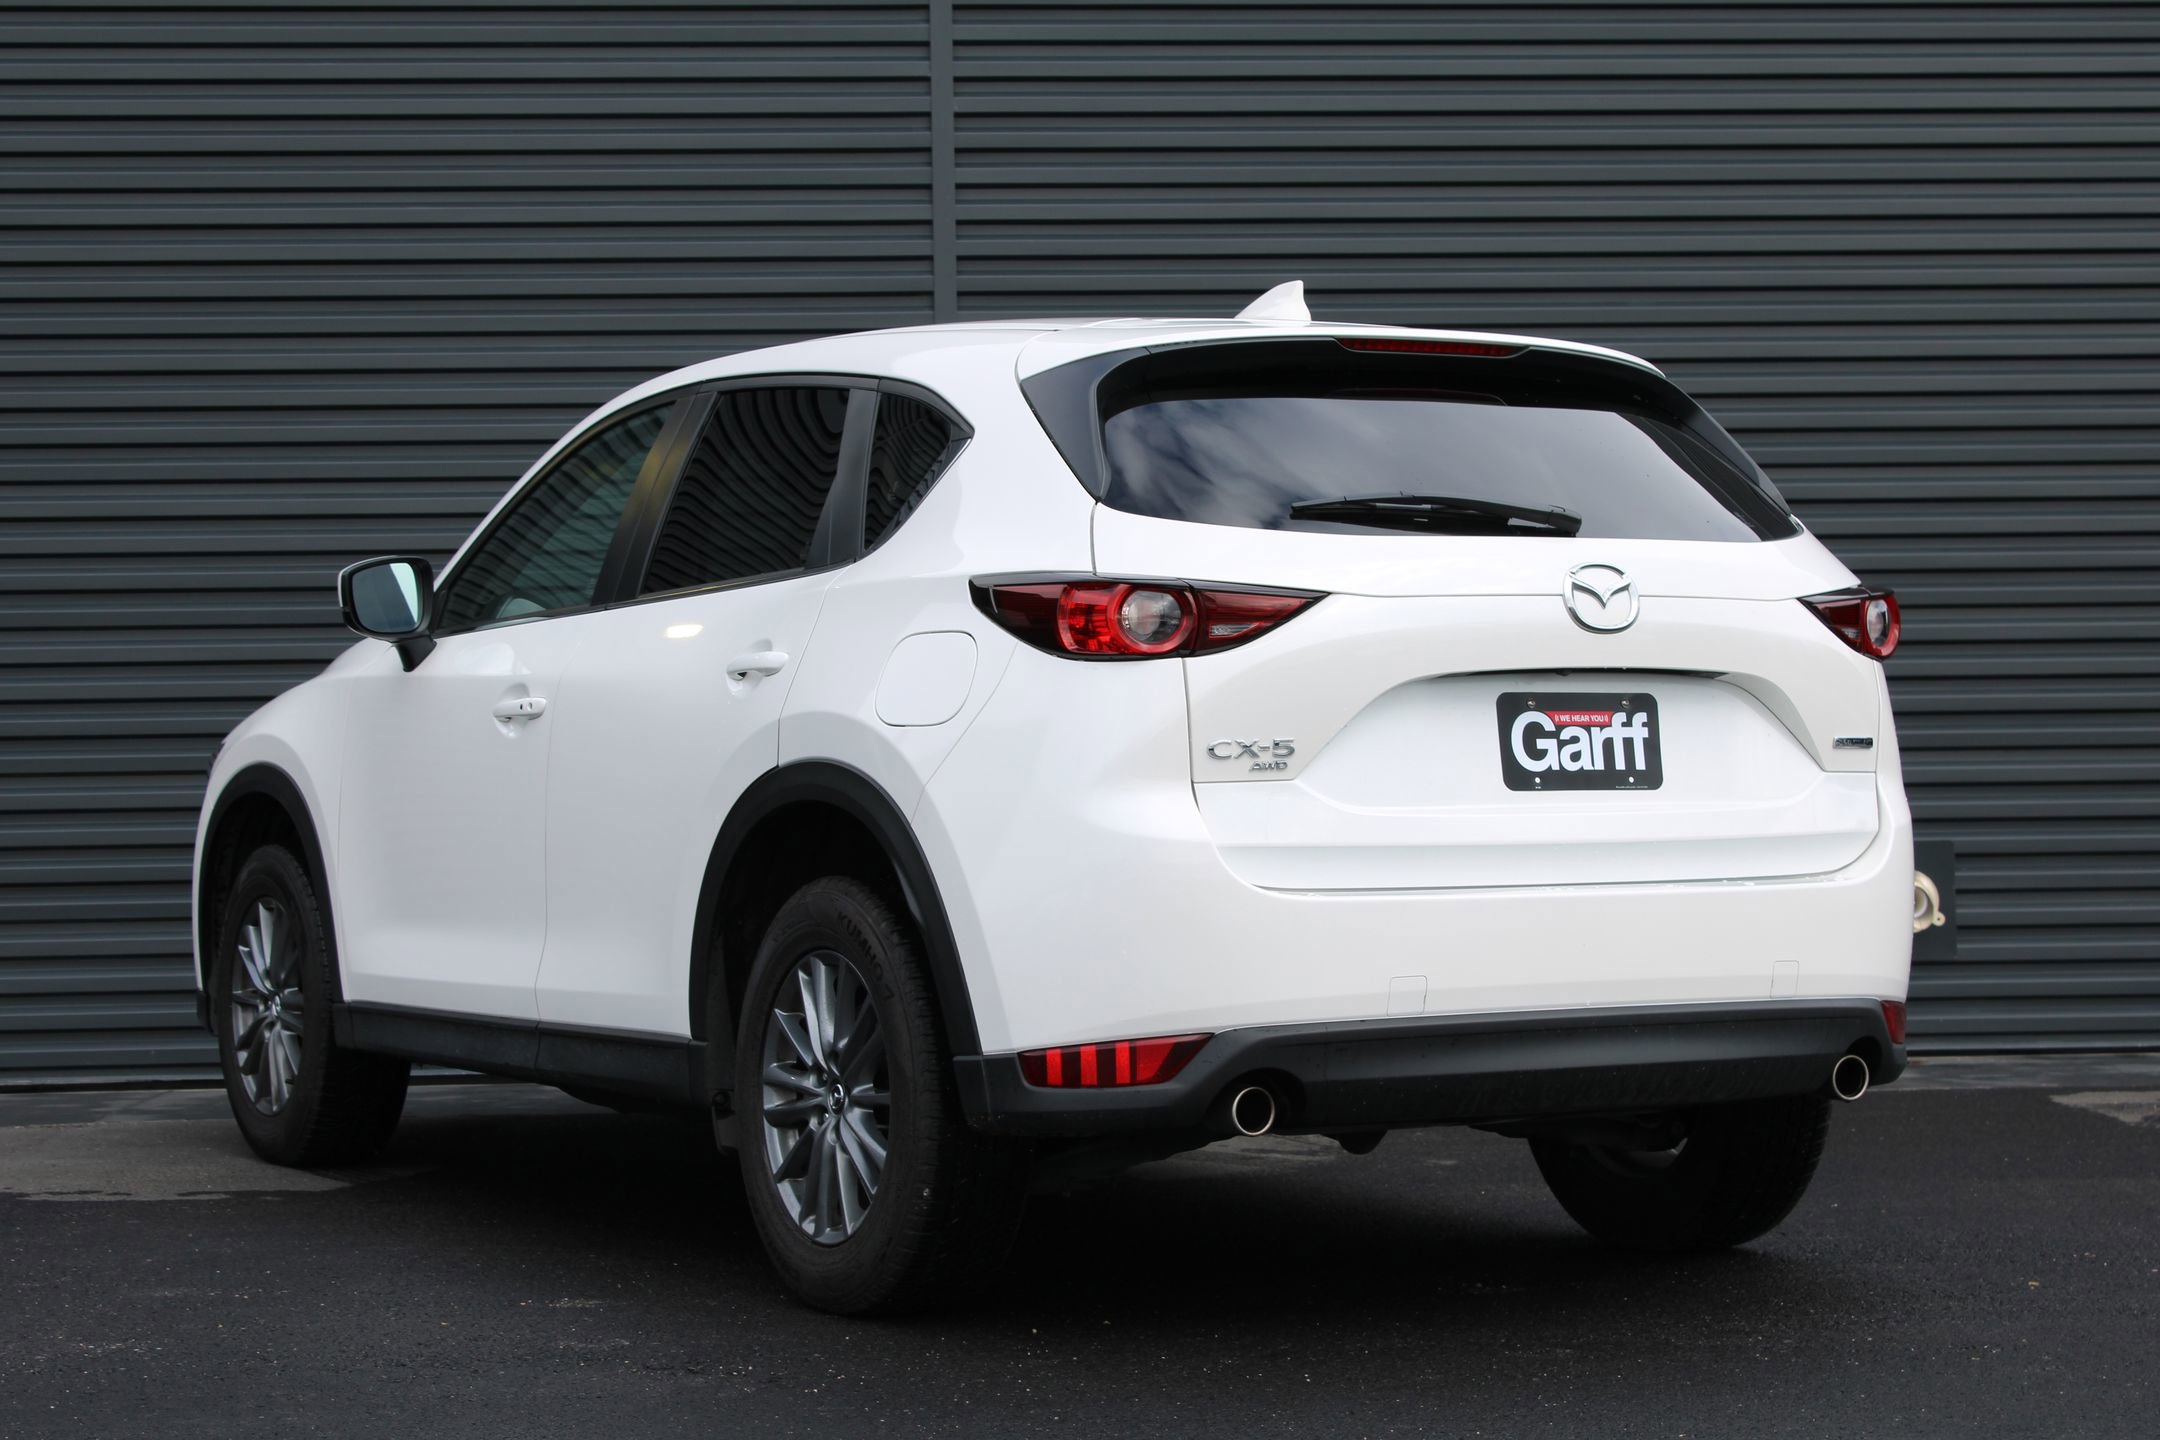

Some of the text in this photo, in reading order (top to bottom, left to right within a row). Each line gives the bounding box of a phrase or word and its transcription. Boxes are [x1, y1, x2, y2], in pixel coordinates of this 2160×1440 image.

[1560, 714, 1604, 722] WE HEAR YOU
[1207, 738, 1296, 761] CX-5
[1511, 711, 1649, 772] Garff
[1249, 760, 1288, 772] AWD
[838, 911, 884, 982] KUMHO
